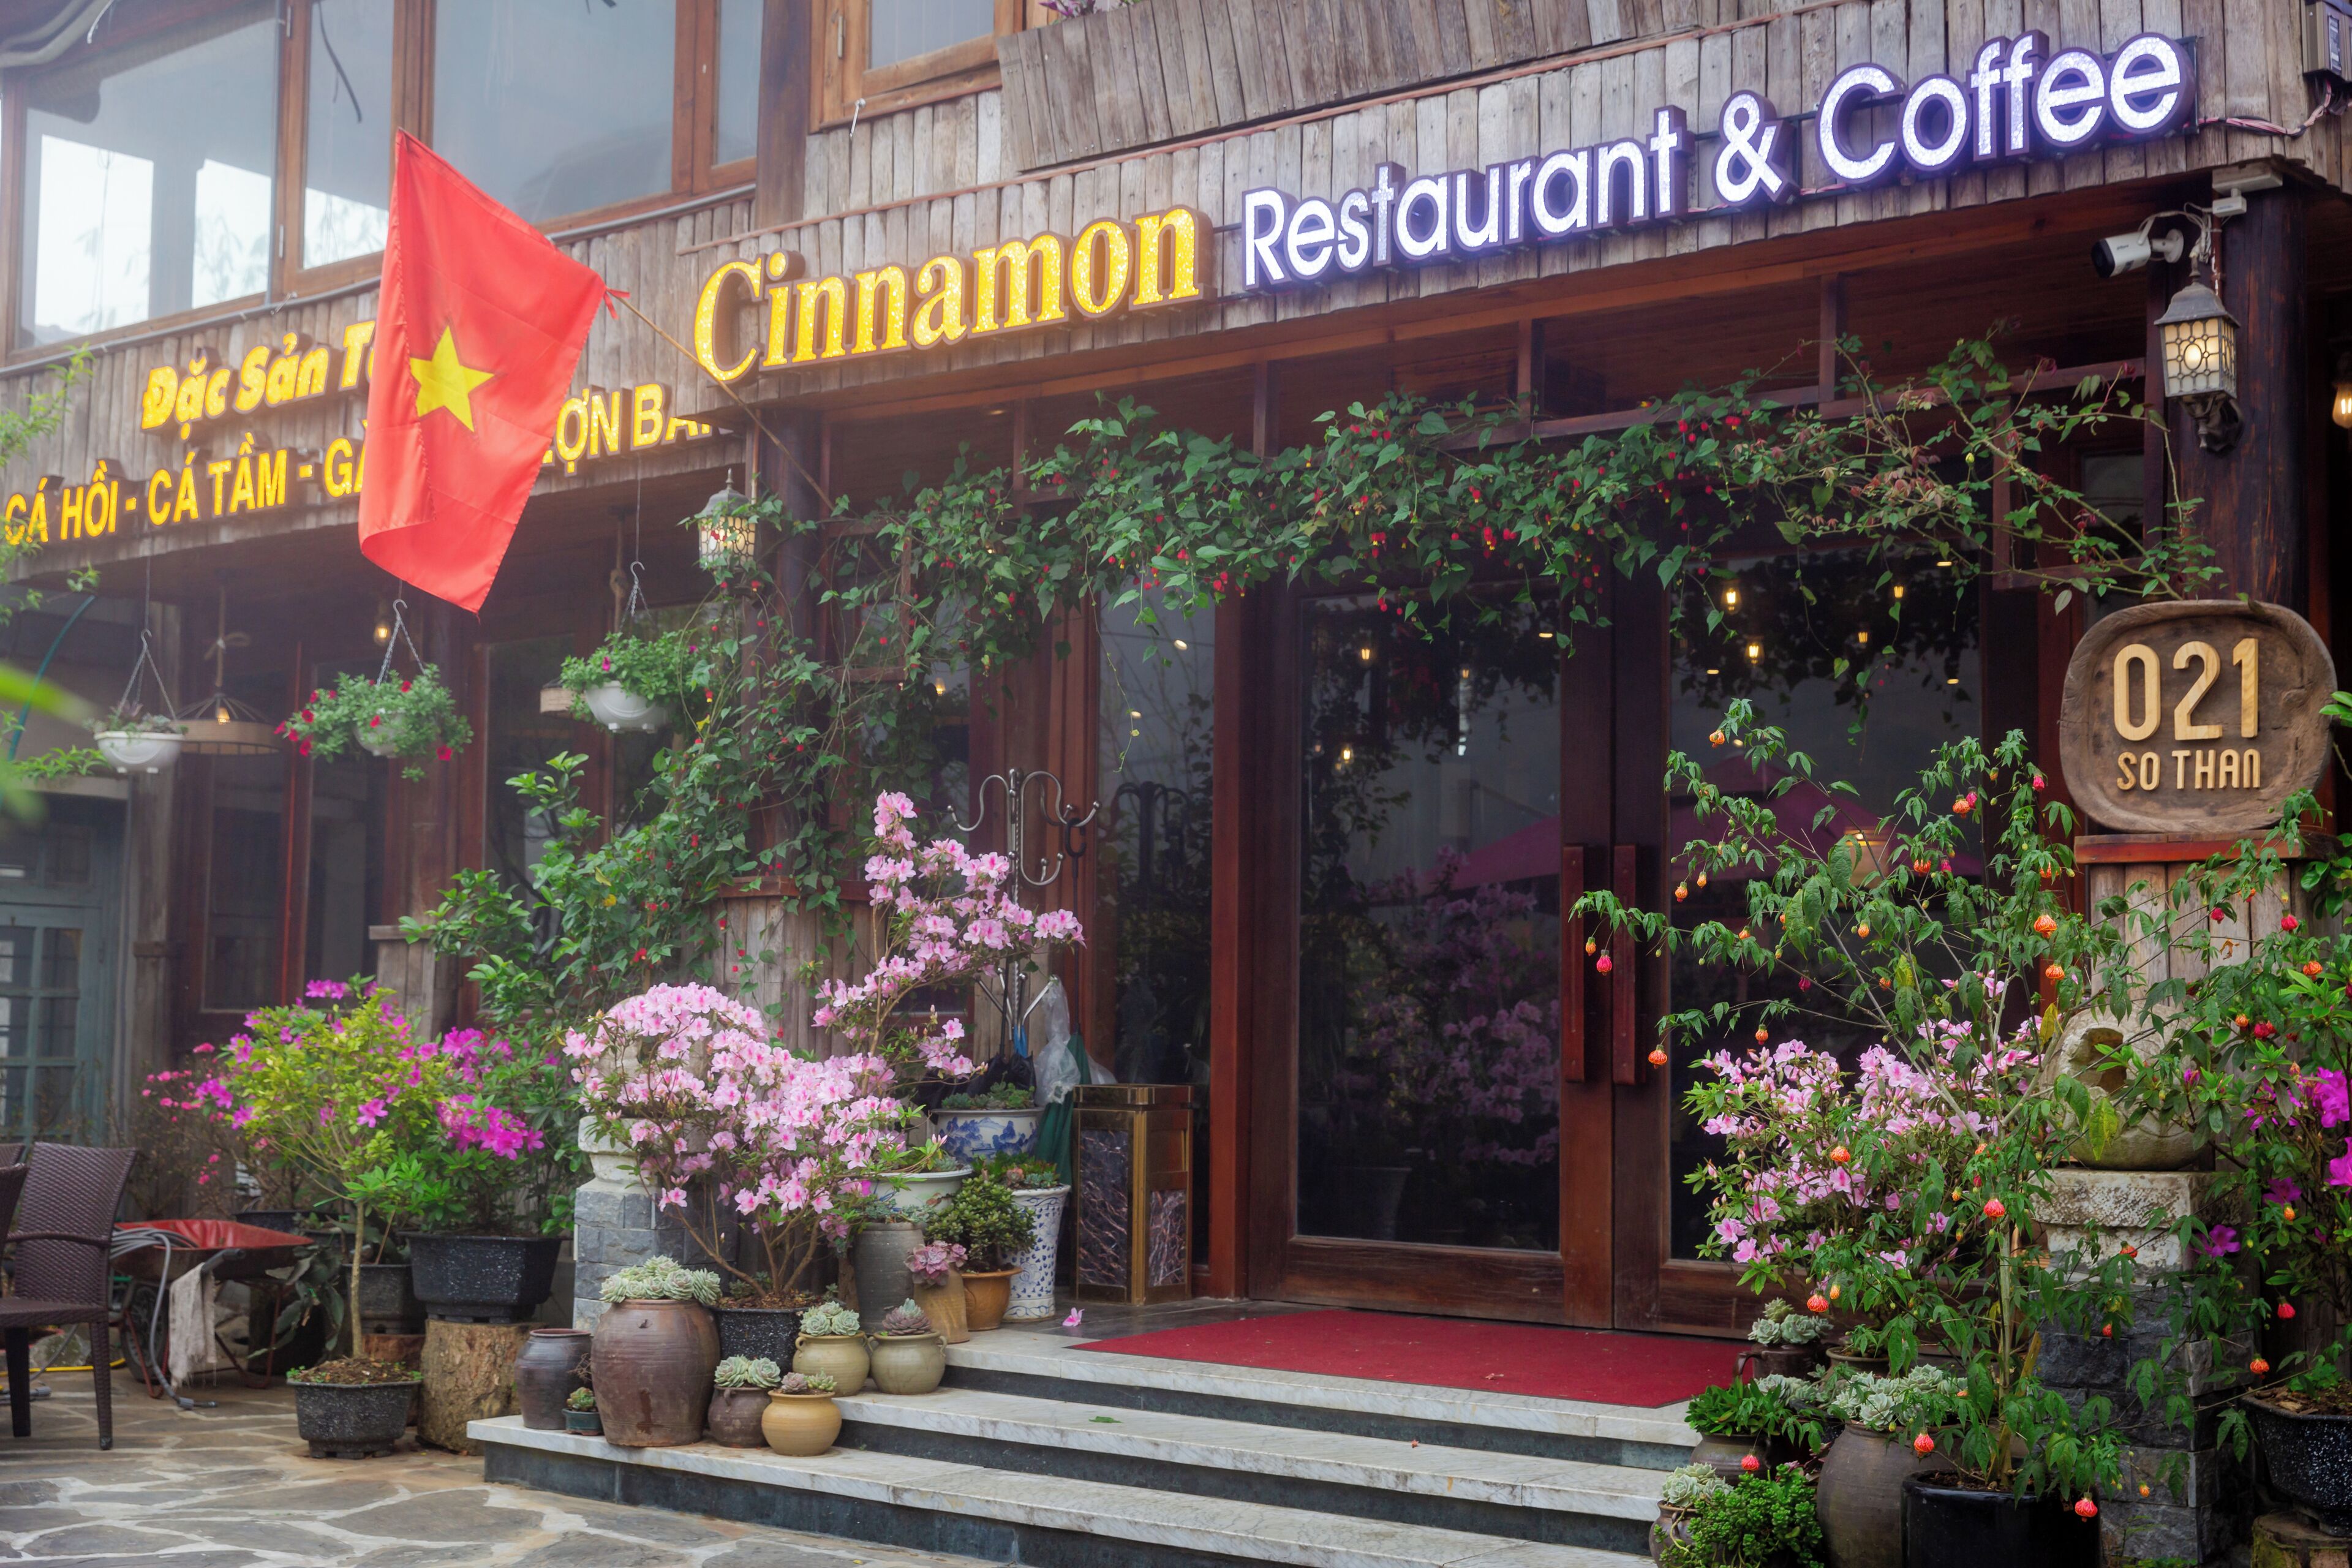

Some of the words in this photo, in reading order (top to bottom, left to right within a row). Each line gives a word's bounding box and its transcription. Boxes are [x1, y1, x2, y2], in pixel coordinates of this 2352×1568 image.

[694, 209, 1199, 380] Cinnamon
[1246, 111, 1677, 285] Restaurant
[1716, 94, 1783, 202] &
[1819, 35, 2181, 179] Coffee
[141, 356, 230, 440] Đặc
[235, 333, 329, 411] Sản
[340, 321, 375, 388] T
[5, 477, 48, 545] CÁ
[61, 460, 118, 540] HỒI
[148, 451, 198, 526] CÁ
[208, 432, 287, 516] TẦM
[2114, 638, 2259, 741] 021
[2117, 751, 2161, 791] SO
[2172, 748, 2261, 790] THAN
